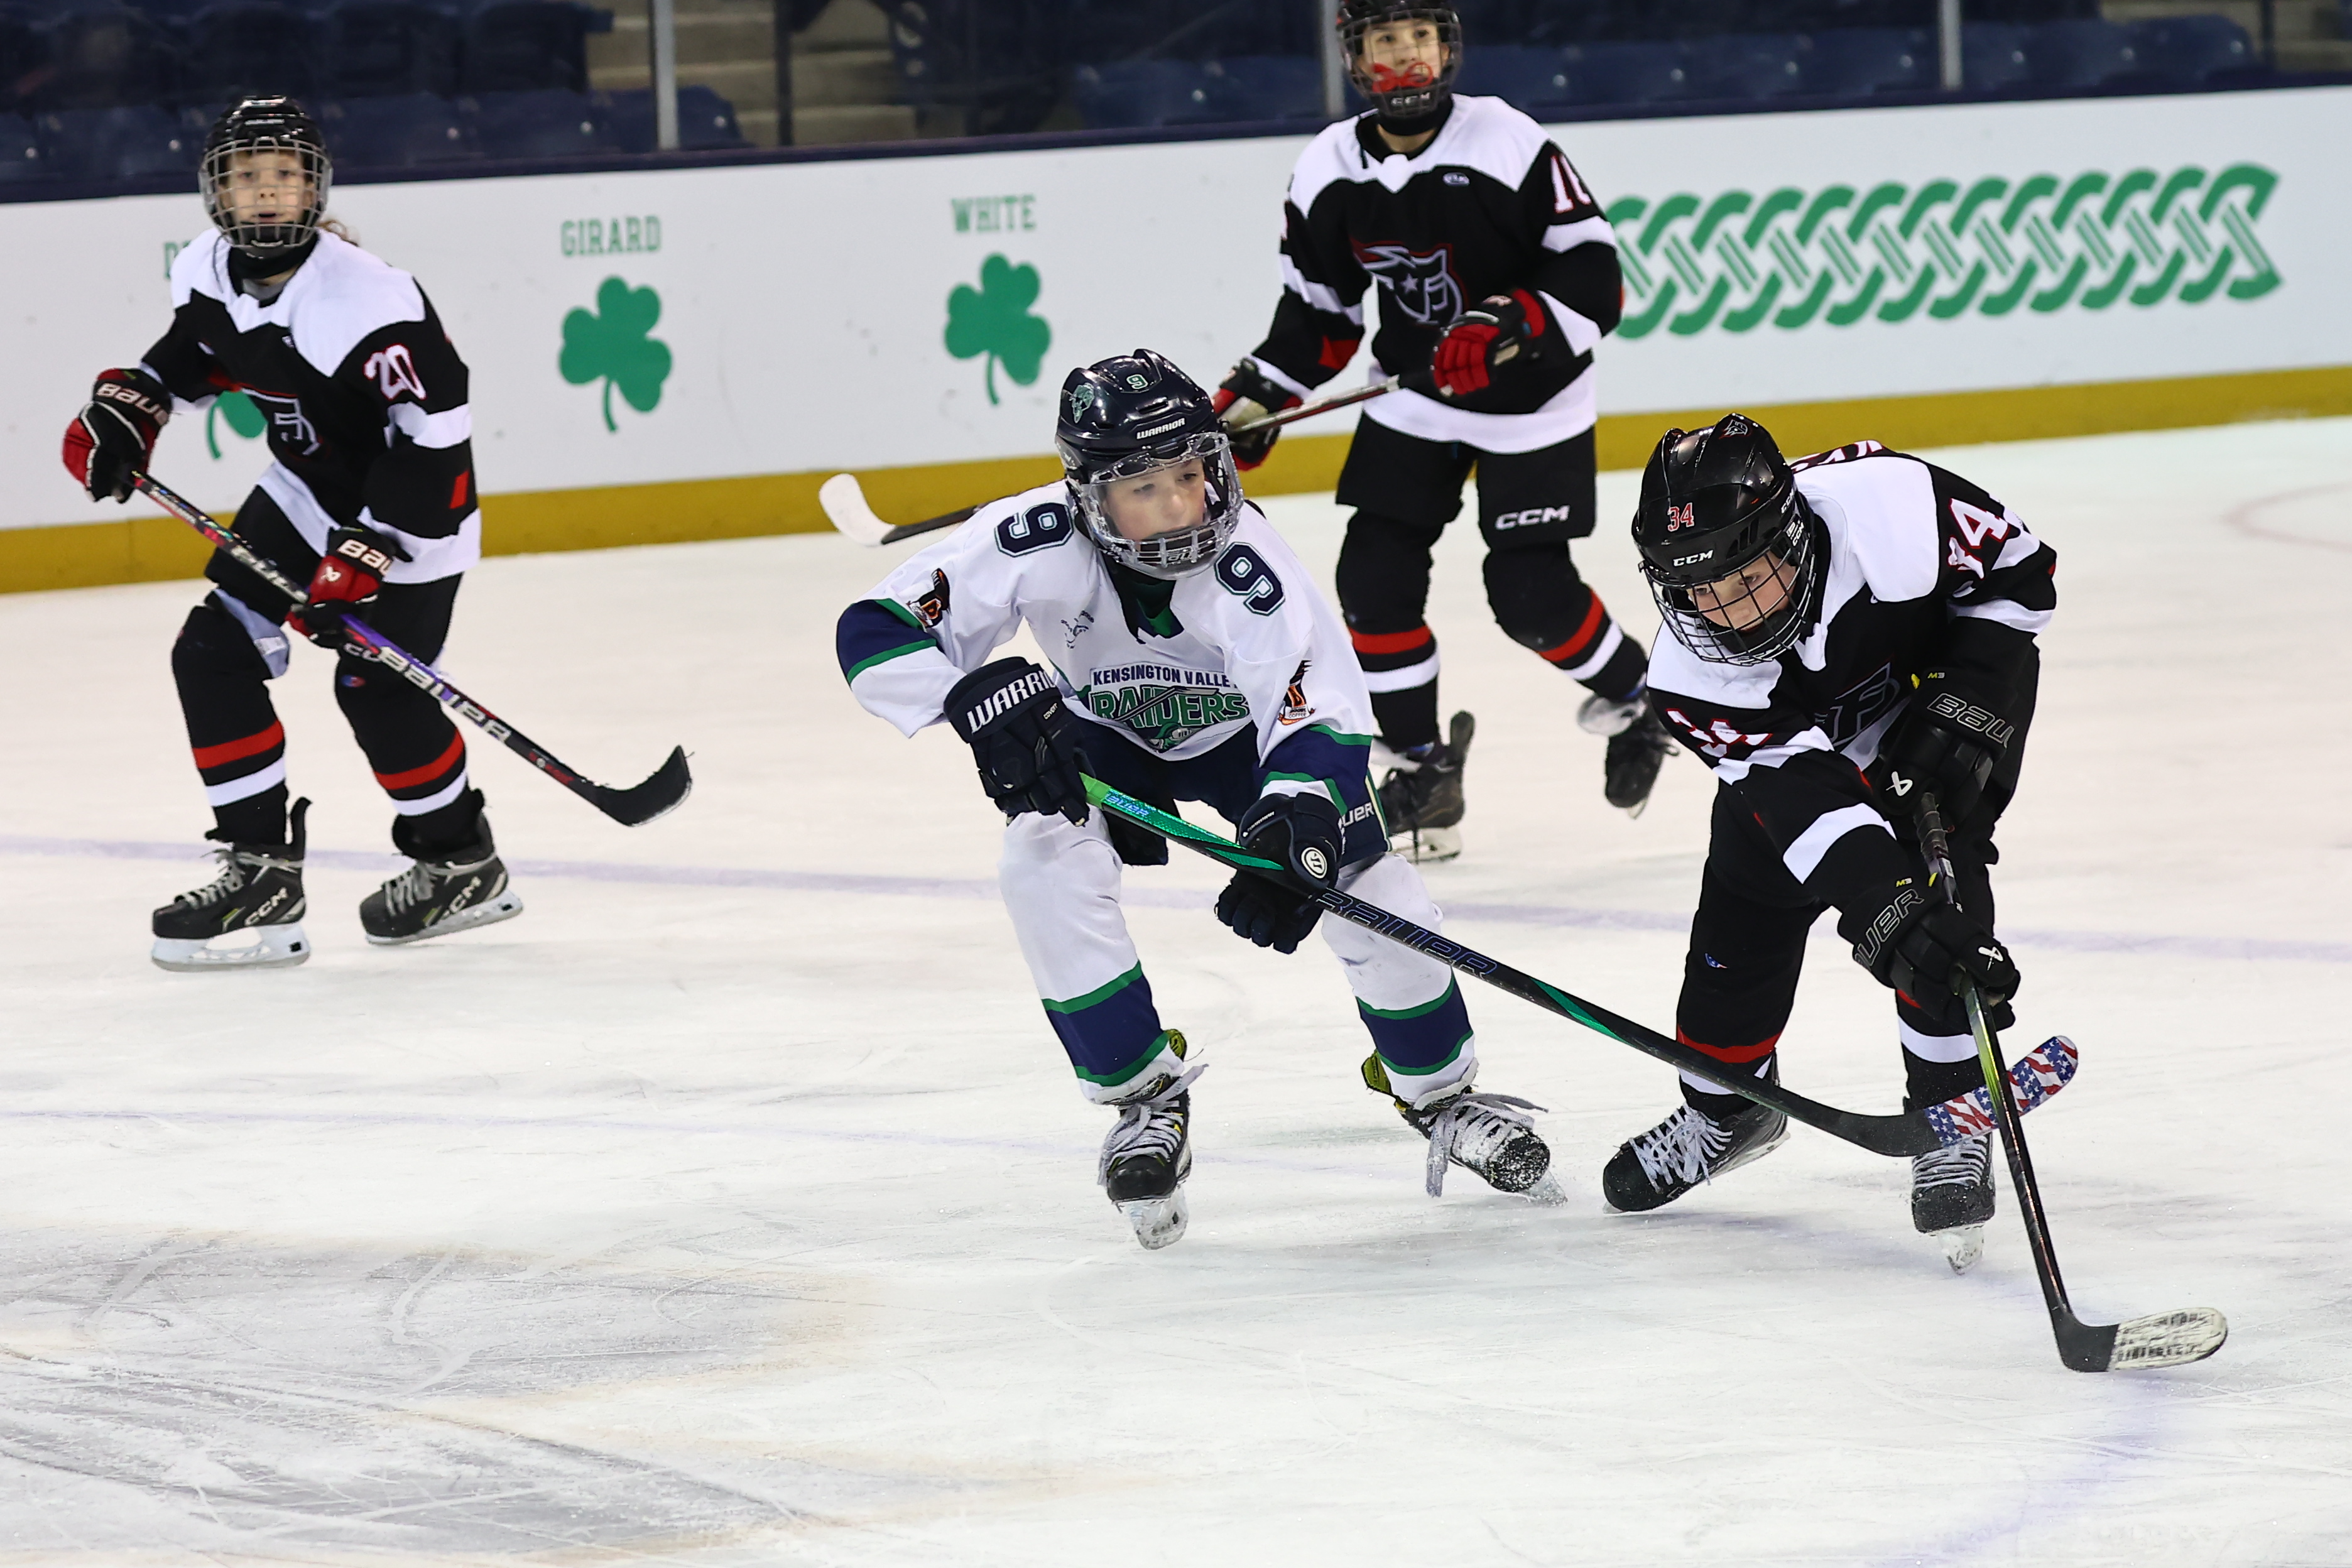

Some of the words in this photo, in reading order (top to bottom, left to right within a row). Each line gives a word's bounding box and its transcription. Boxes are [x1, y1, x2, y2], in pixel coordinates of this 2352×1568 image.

[950, 194, 1037, 233] WHITE
[561, 215, 662, 256] GIRARD
[362, 342, 427, 401] 20
[1126, 374, 1148, 389] 9
[1136, 417, 1186, 439] WARRIOR
[994, 501, 1074, 558] 9
[1494, 504, 1571, 530] CCM
[1667, 502, 1695, 532] 34
[1673, 550, 1714, 567] CCM
[1214, 542, 1286, 617] 9
[378, 645, 512, 742] BAUER
[1093, 664, 1180, 685] KENSINGTON
[1184, 670, 1238, 689] VALLE
[1090, 685, 1250, 729] RAIDERS
[1342, 802, 1375, 827] UER
[1896, 878, 1912, 887] M3
[244, 886, 290, 926] CCM
[1315, 888, 1498, 979] BAUER
